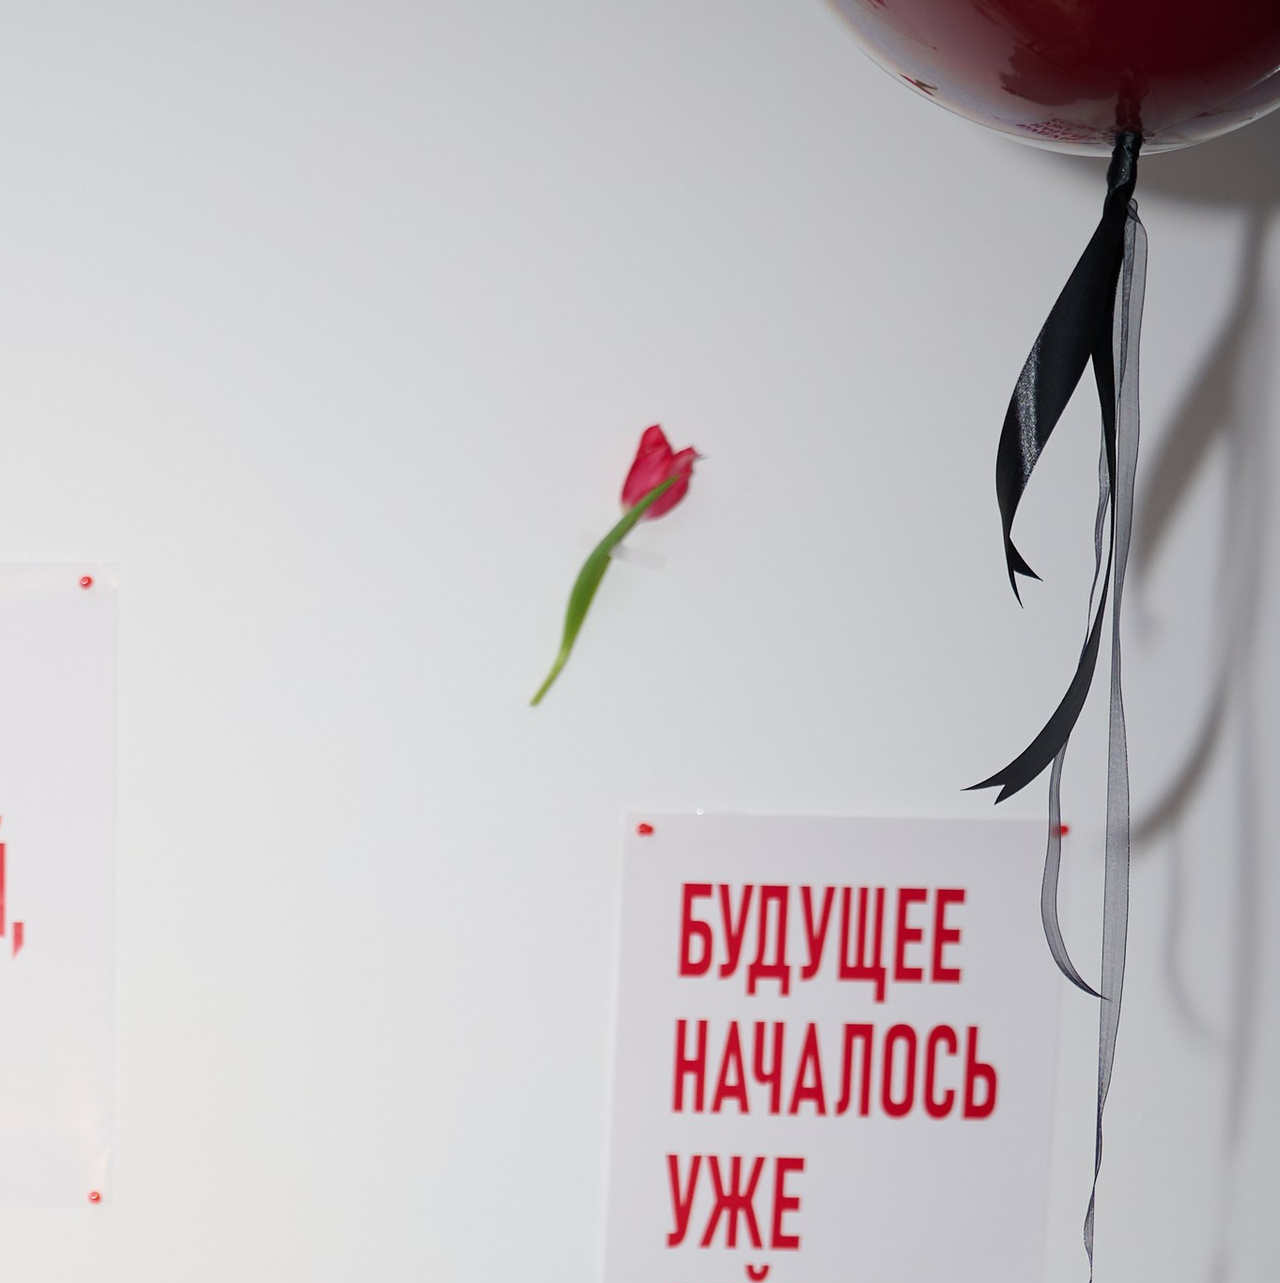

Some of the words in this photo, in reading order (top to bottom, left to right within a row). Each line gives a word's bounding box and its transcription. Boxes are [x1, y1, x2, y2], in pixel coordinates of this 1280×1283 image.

[677, 881, 966, 1004] БУДУЩЕЕ
[671, 1018, 999, 1121] НАЧАЛОСЬ
[665, 1153, 806, 1251] УЖЕ
